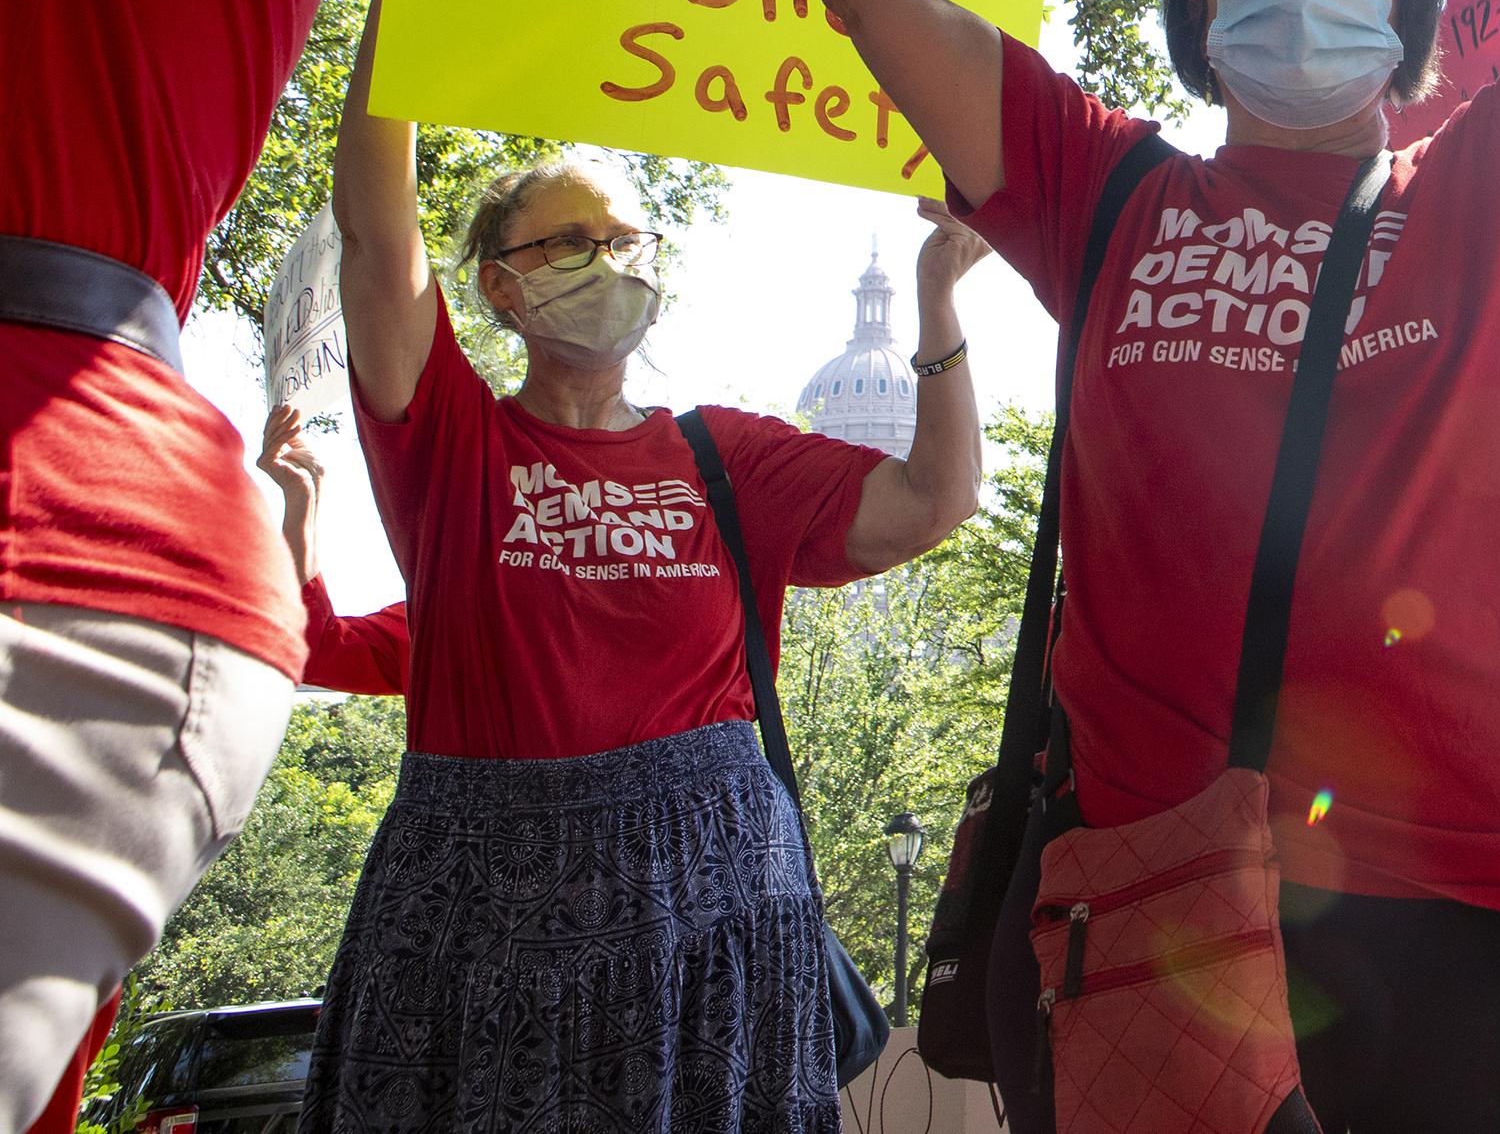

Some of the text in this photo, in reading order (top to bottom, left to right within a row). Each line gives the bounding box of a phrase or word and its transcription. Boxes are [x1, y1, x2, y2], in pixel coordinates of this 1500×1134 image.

[1153, 207, 1334, 254] MOMS
[1107, 340, 1146, 368] FOR
[1152, 339, 1202, 364] GUN
[1209, 345, 1286, 372] SENSE
[1335, 318, 1439, 372] MERICA
[499, 550, 721, 581] FOR GUN SENSE IN AMERICA
